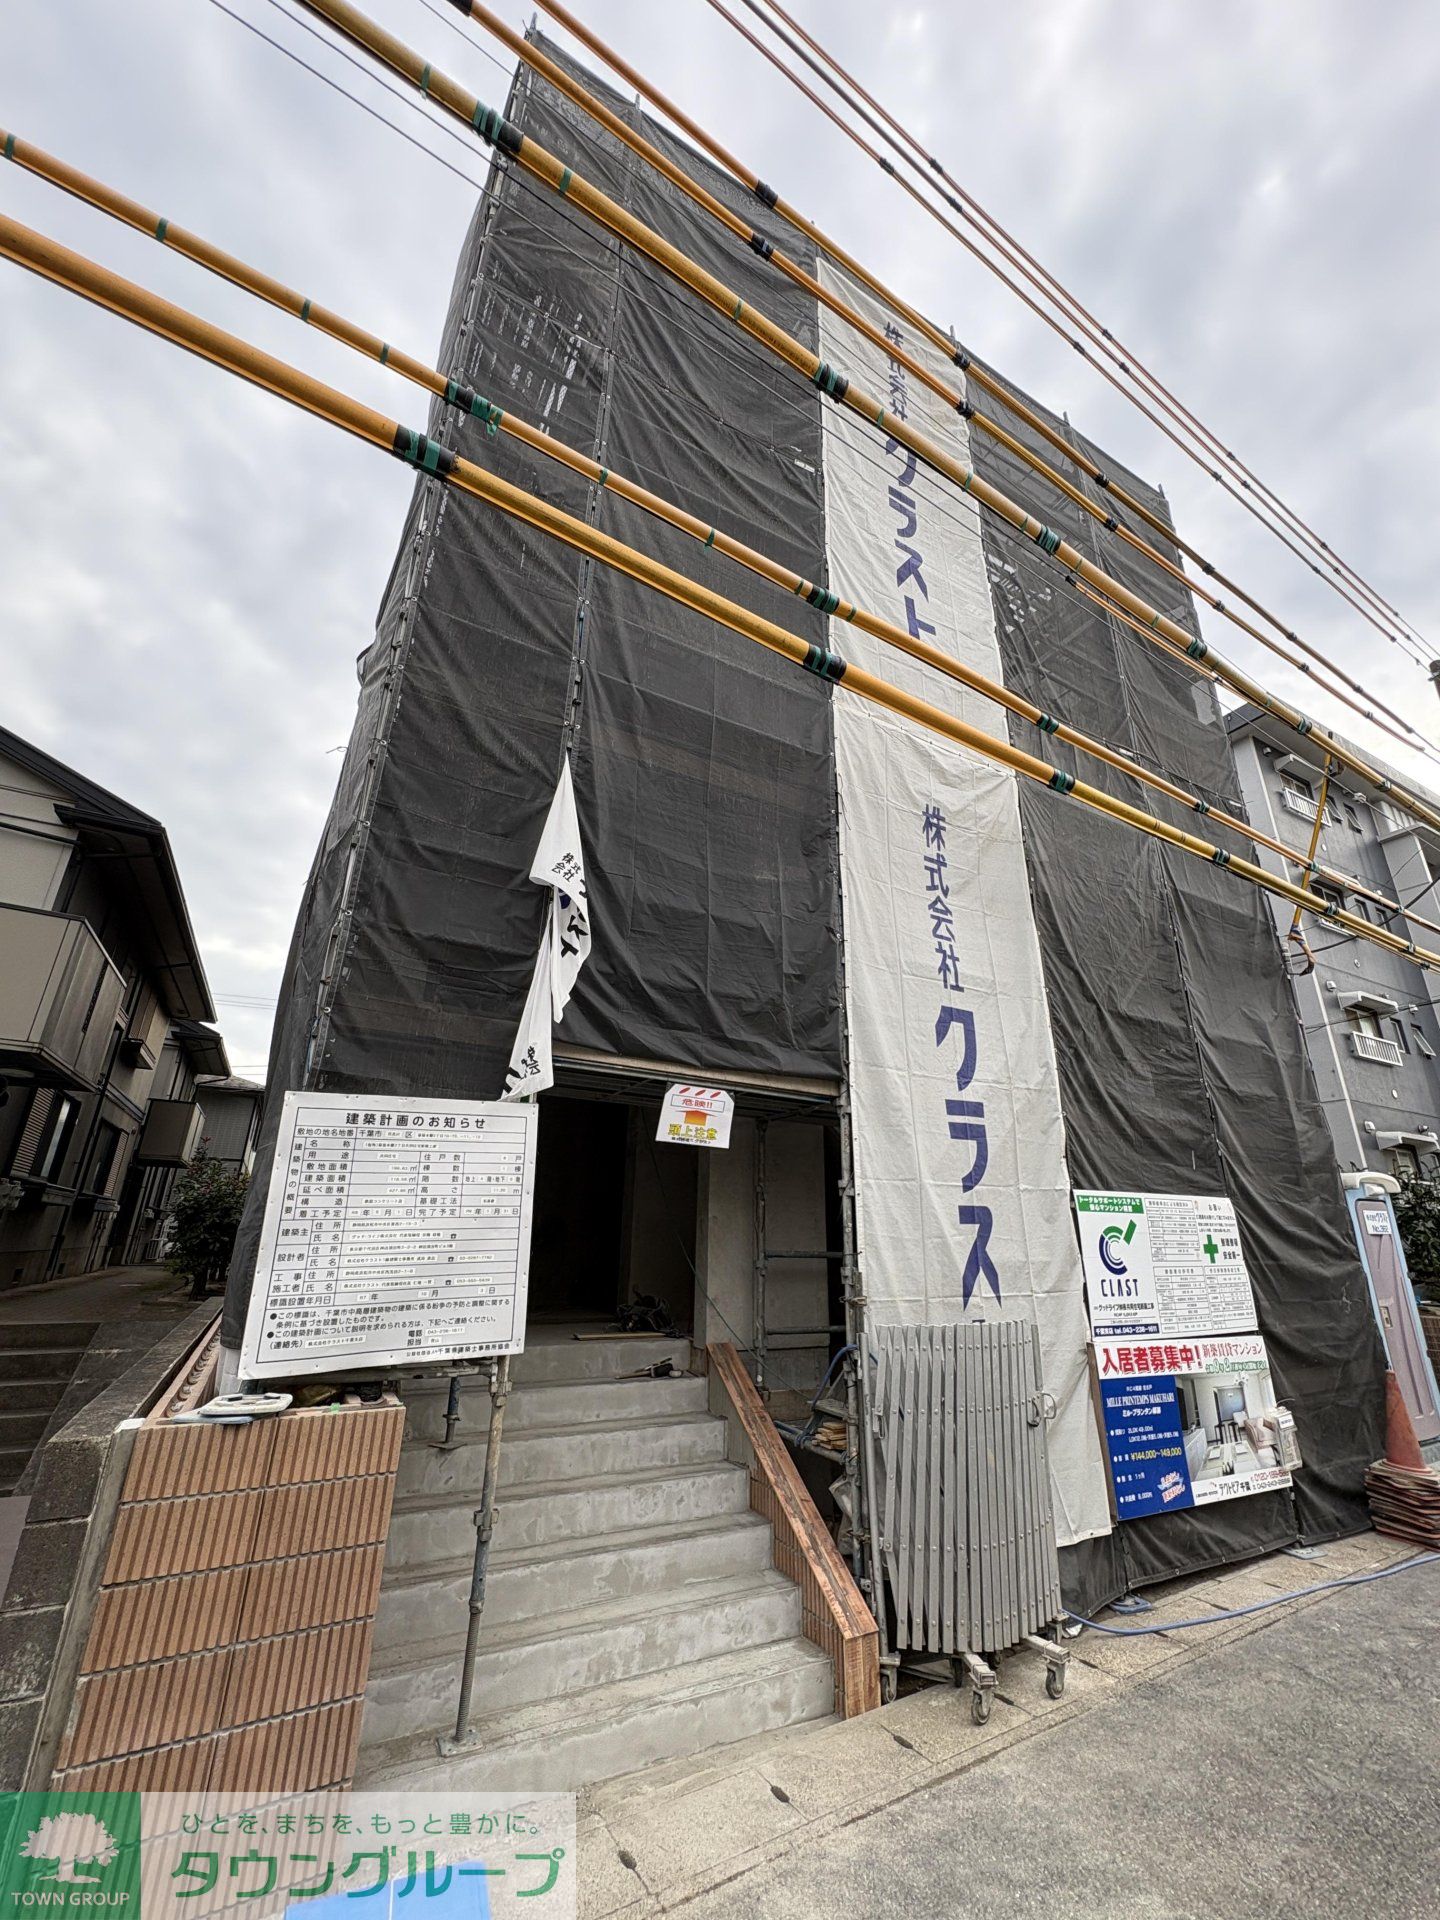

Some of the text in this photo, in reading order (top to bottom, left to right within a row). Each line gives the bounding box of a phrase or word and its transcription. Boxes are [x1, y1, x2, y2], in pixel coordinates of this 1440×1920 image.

[922, 804, 1002, 1323] 株式会社クラス
[346, 1112, 486, 1129] 建築計画のお知らせ
[297, 1128, 354, 1137] 敷地の地名地番
[360, 1129, 382, 1137] 千葉市
[405, 1131, 413, 1139] 区
[668, 1123, 718, 1140] 頭上注意
[306, 1162, 348, 1171] 敷地面積
[302, 1186, 345, 1194] 延べ面積
[419, 1197, 458, 1205] 基礎工法
[299, 1209, 342, 1218] 着工予定
[418, 1208, 457, 1216] 完了予定
[315, 1222, 342, 1230] 住所
[281, 1228, 309, 1237] 建築主
[313, 1234, 340, 1242] 氏名
[311, 1245, 338, 1255] 住所
[277, 1253, 305, 1262] 設計者
[309, 1258, 337, 1267] 氏名
[308, 1270, 335, 1279] 住所
[305, 1283, 333, 1292] 氏名
[1100, 1278, 1138, 1297] CLAST
[269, 1296, 331, 1307] 標識設置年月日
[1202, 1342, 1263, 1358] 新築賃貸マンション
[1102, 1344, 1202, 1373] 入居者募集中!
[1106, 1396, 1122, 1408] MILLE
[1122, 1394, 1150, 1406] PRINTEMPS
